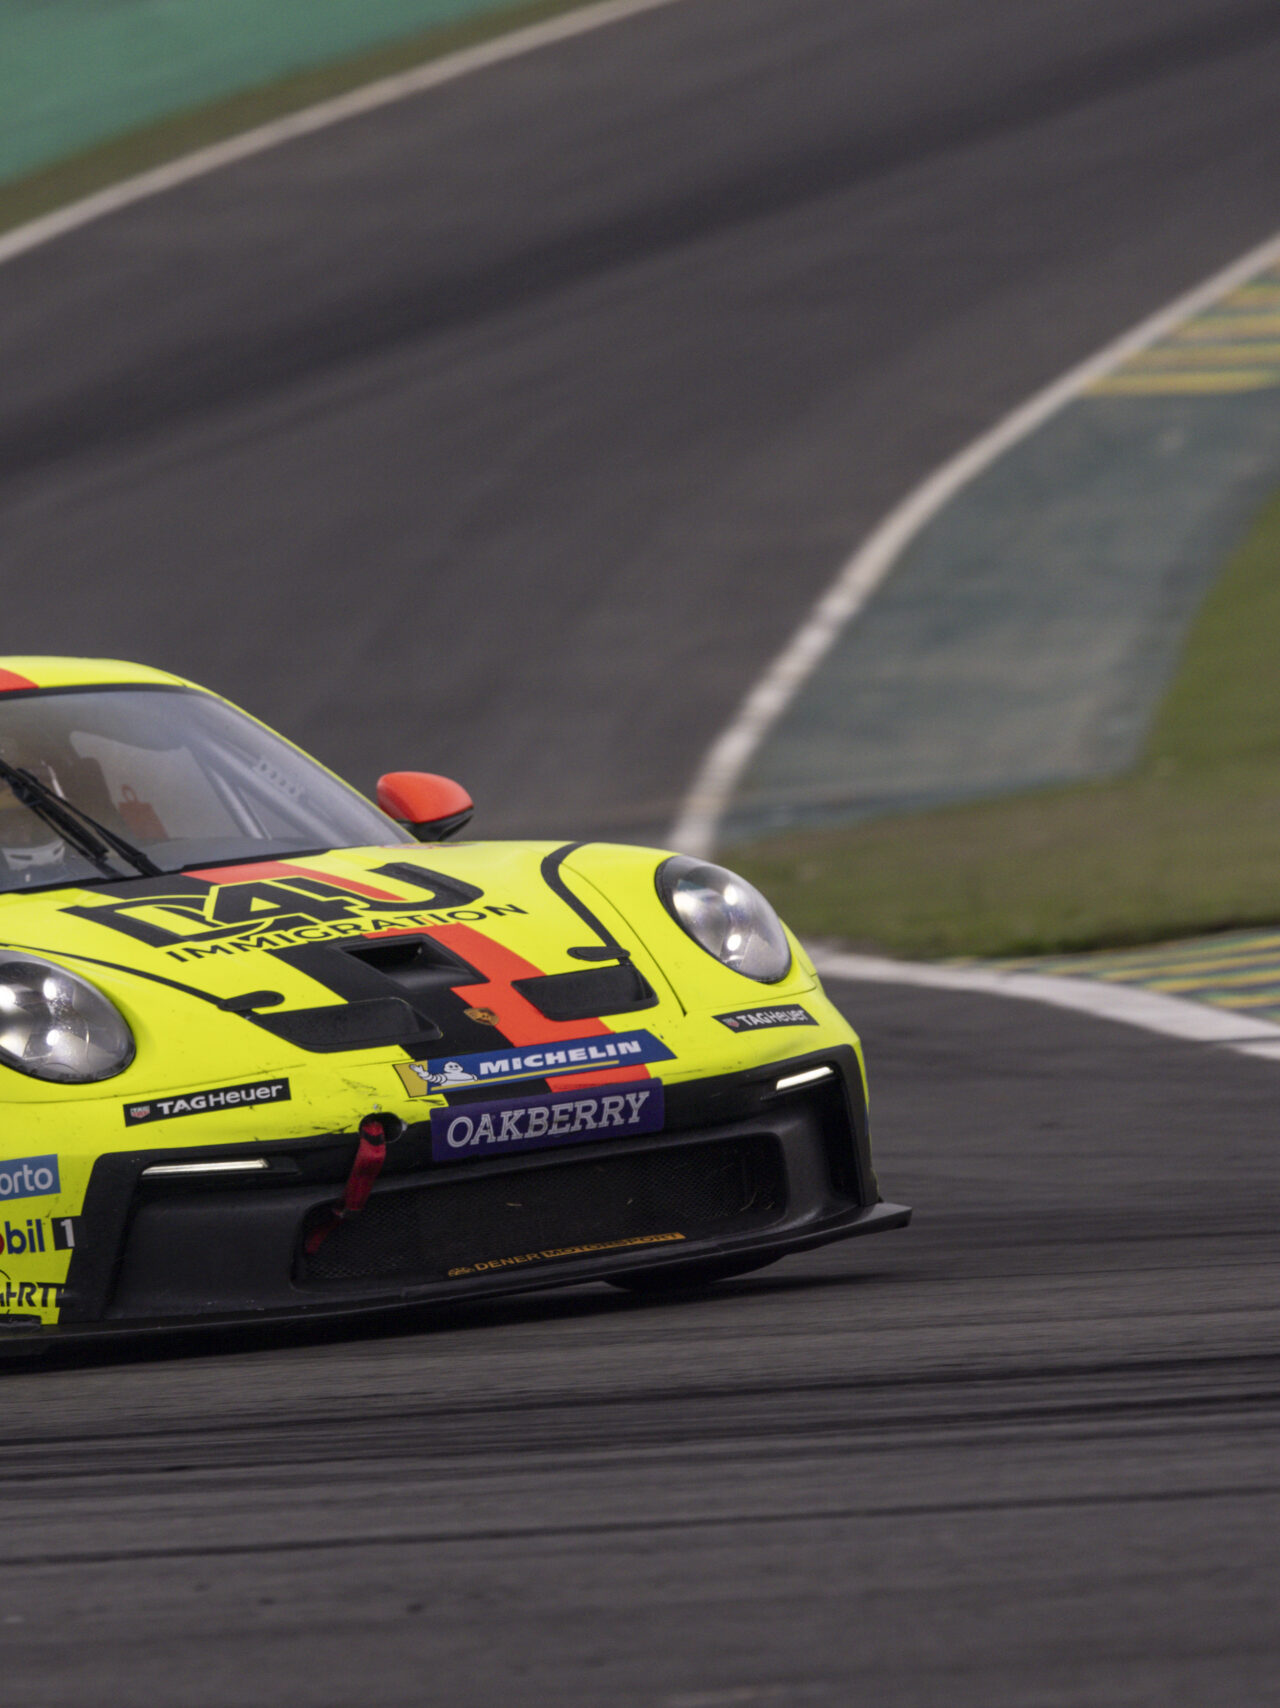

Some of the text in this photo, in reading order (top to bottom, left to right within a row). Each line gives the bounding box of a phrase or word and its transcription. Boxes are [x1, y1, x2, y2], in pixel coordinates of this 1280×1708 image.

[165, 902, 529, 963] IMMIGRATION
[478, 1039, 642, 1076] MICHELIN
[446, 1090, 651, 1149] OAKBERRY
[60, 1218, 76, 1248] 1
[473, 1253, 541, 1272] DENER
